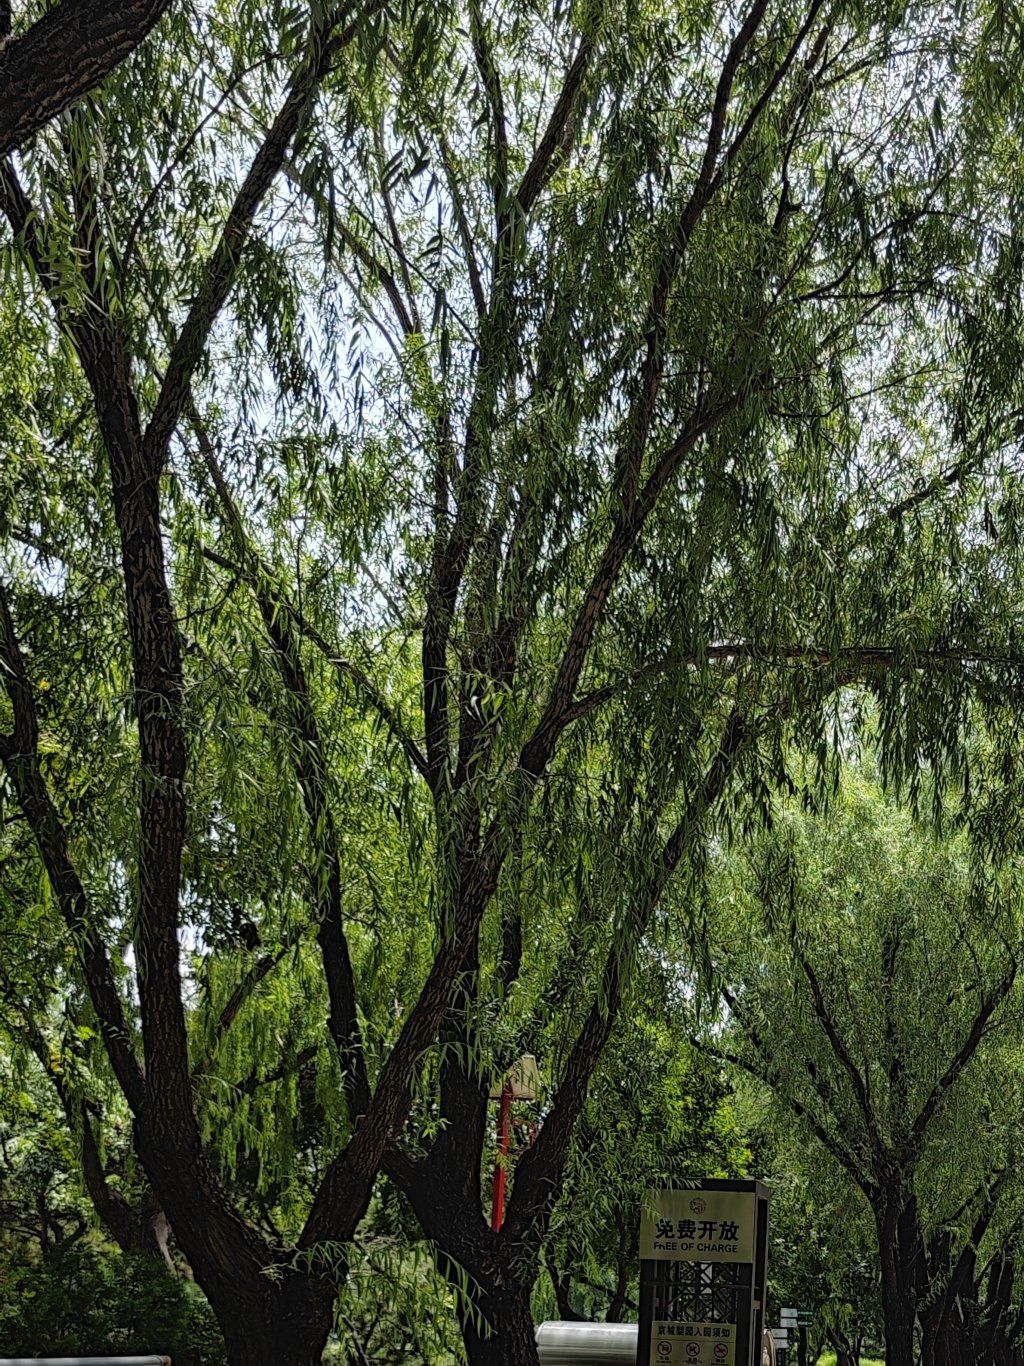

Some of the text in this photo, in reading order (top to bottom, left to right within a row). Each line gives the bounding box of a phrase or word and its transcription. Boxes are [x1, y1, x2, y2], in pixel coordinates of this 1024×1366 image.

[655, 1219, 739, 1241] 免费开放
[681, 1242, 694, 1251] OF
[697, 1243, 738, 1253] CHARGE
